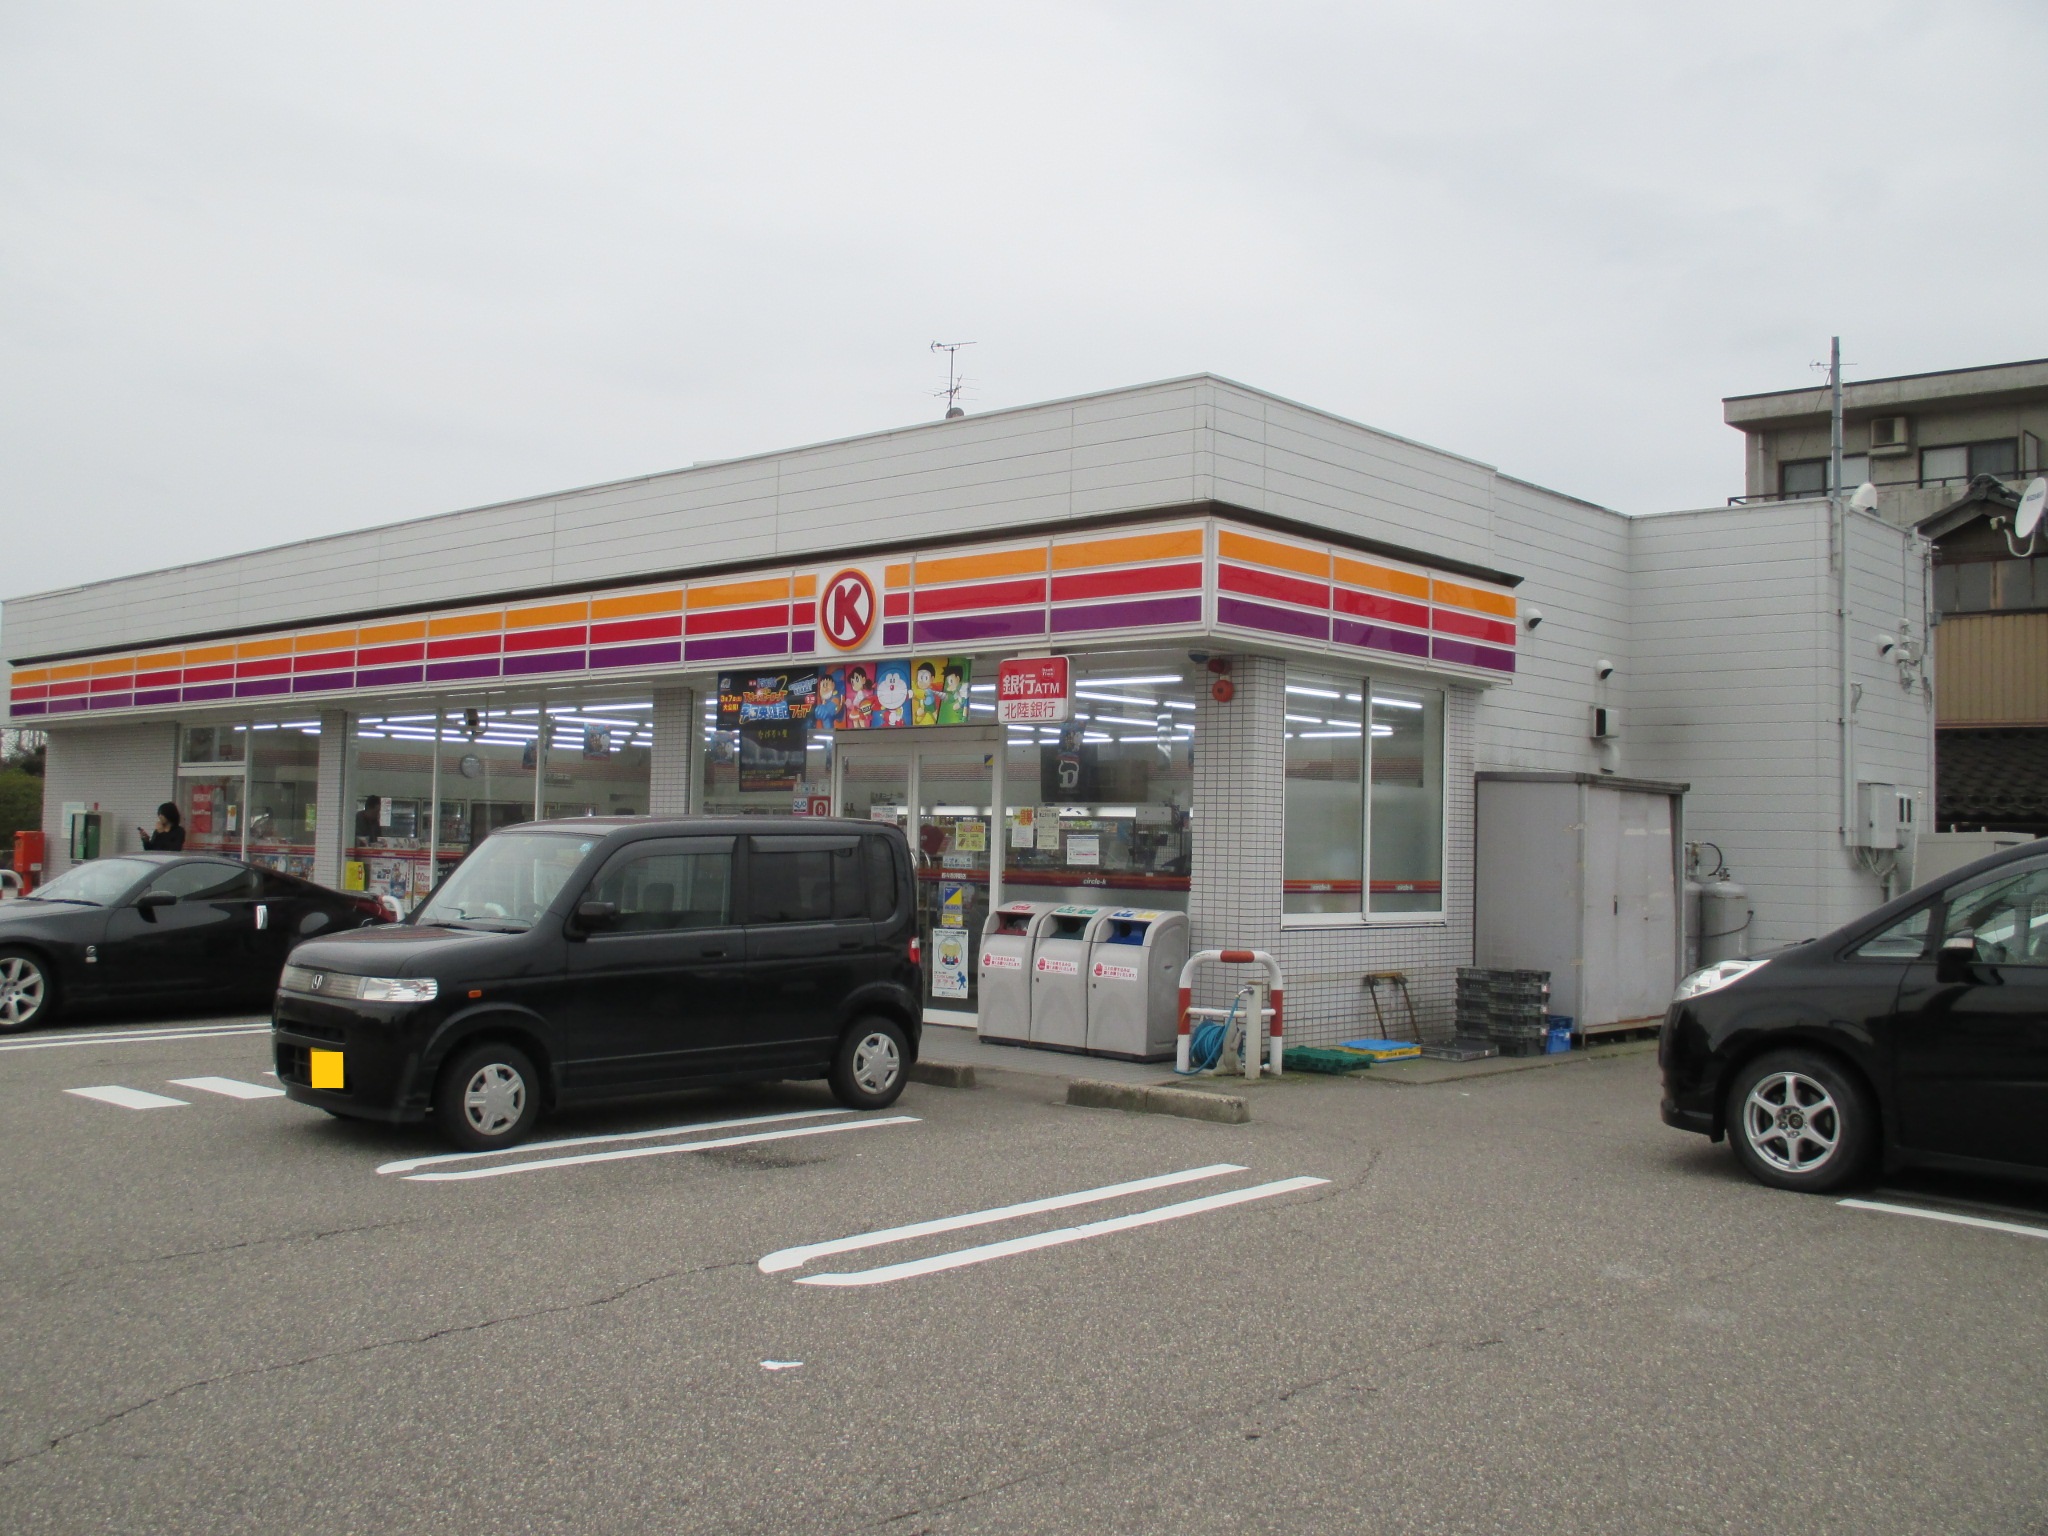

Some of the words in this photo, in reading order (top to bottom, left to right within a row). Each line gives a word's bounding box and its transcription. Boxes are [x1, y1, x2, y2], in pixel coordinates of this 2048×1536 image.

[834, 583, 865, 637] K
[1003, 673, 1060, 695] 銀行ATM
[1004, 701, 1056, 719] 北陸銀行
